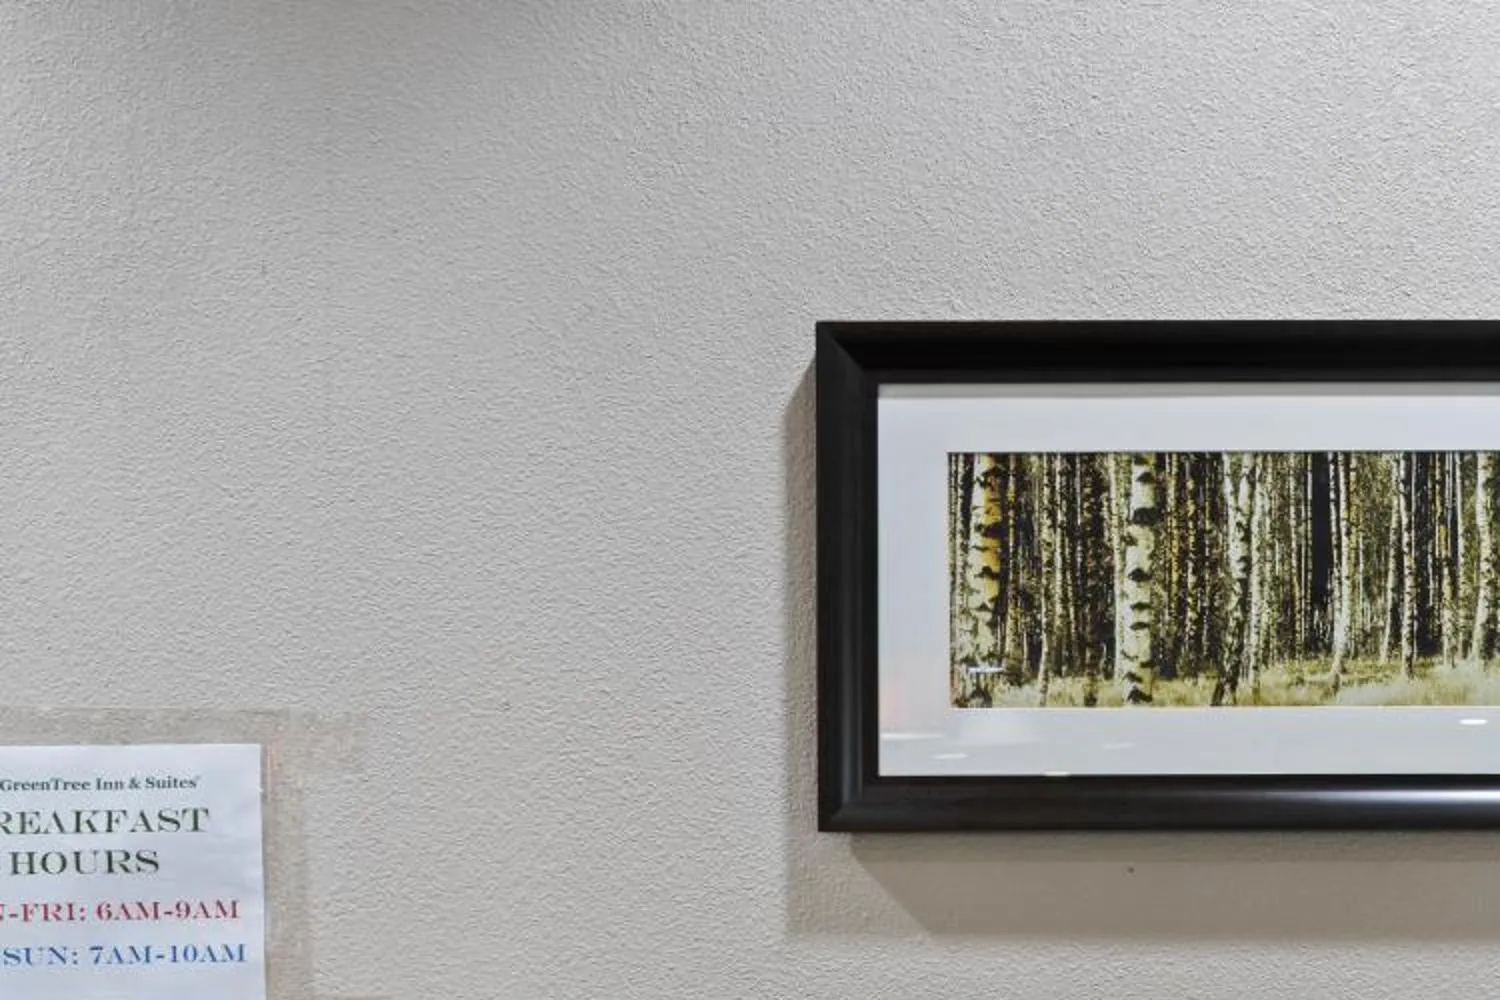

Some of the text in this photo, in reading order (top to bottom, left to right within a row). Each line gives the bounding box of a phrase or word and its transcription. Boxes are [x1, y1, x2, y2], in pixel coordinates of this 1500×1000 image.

[95, 777, 124, 790] Inn
[128, 777, 141, 790] &
[9, 849, 160, 876] HOURS
[0, 899, 241, 923] -FRI: 6AM-9AM
[89, 942, 247, 965] 7AM-10AM
